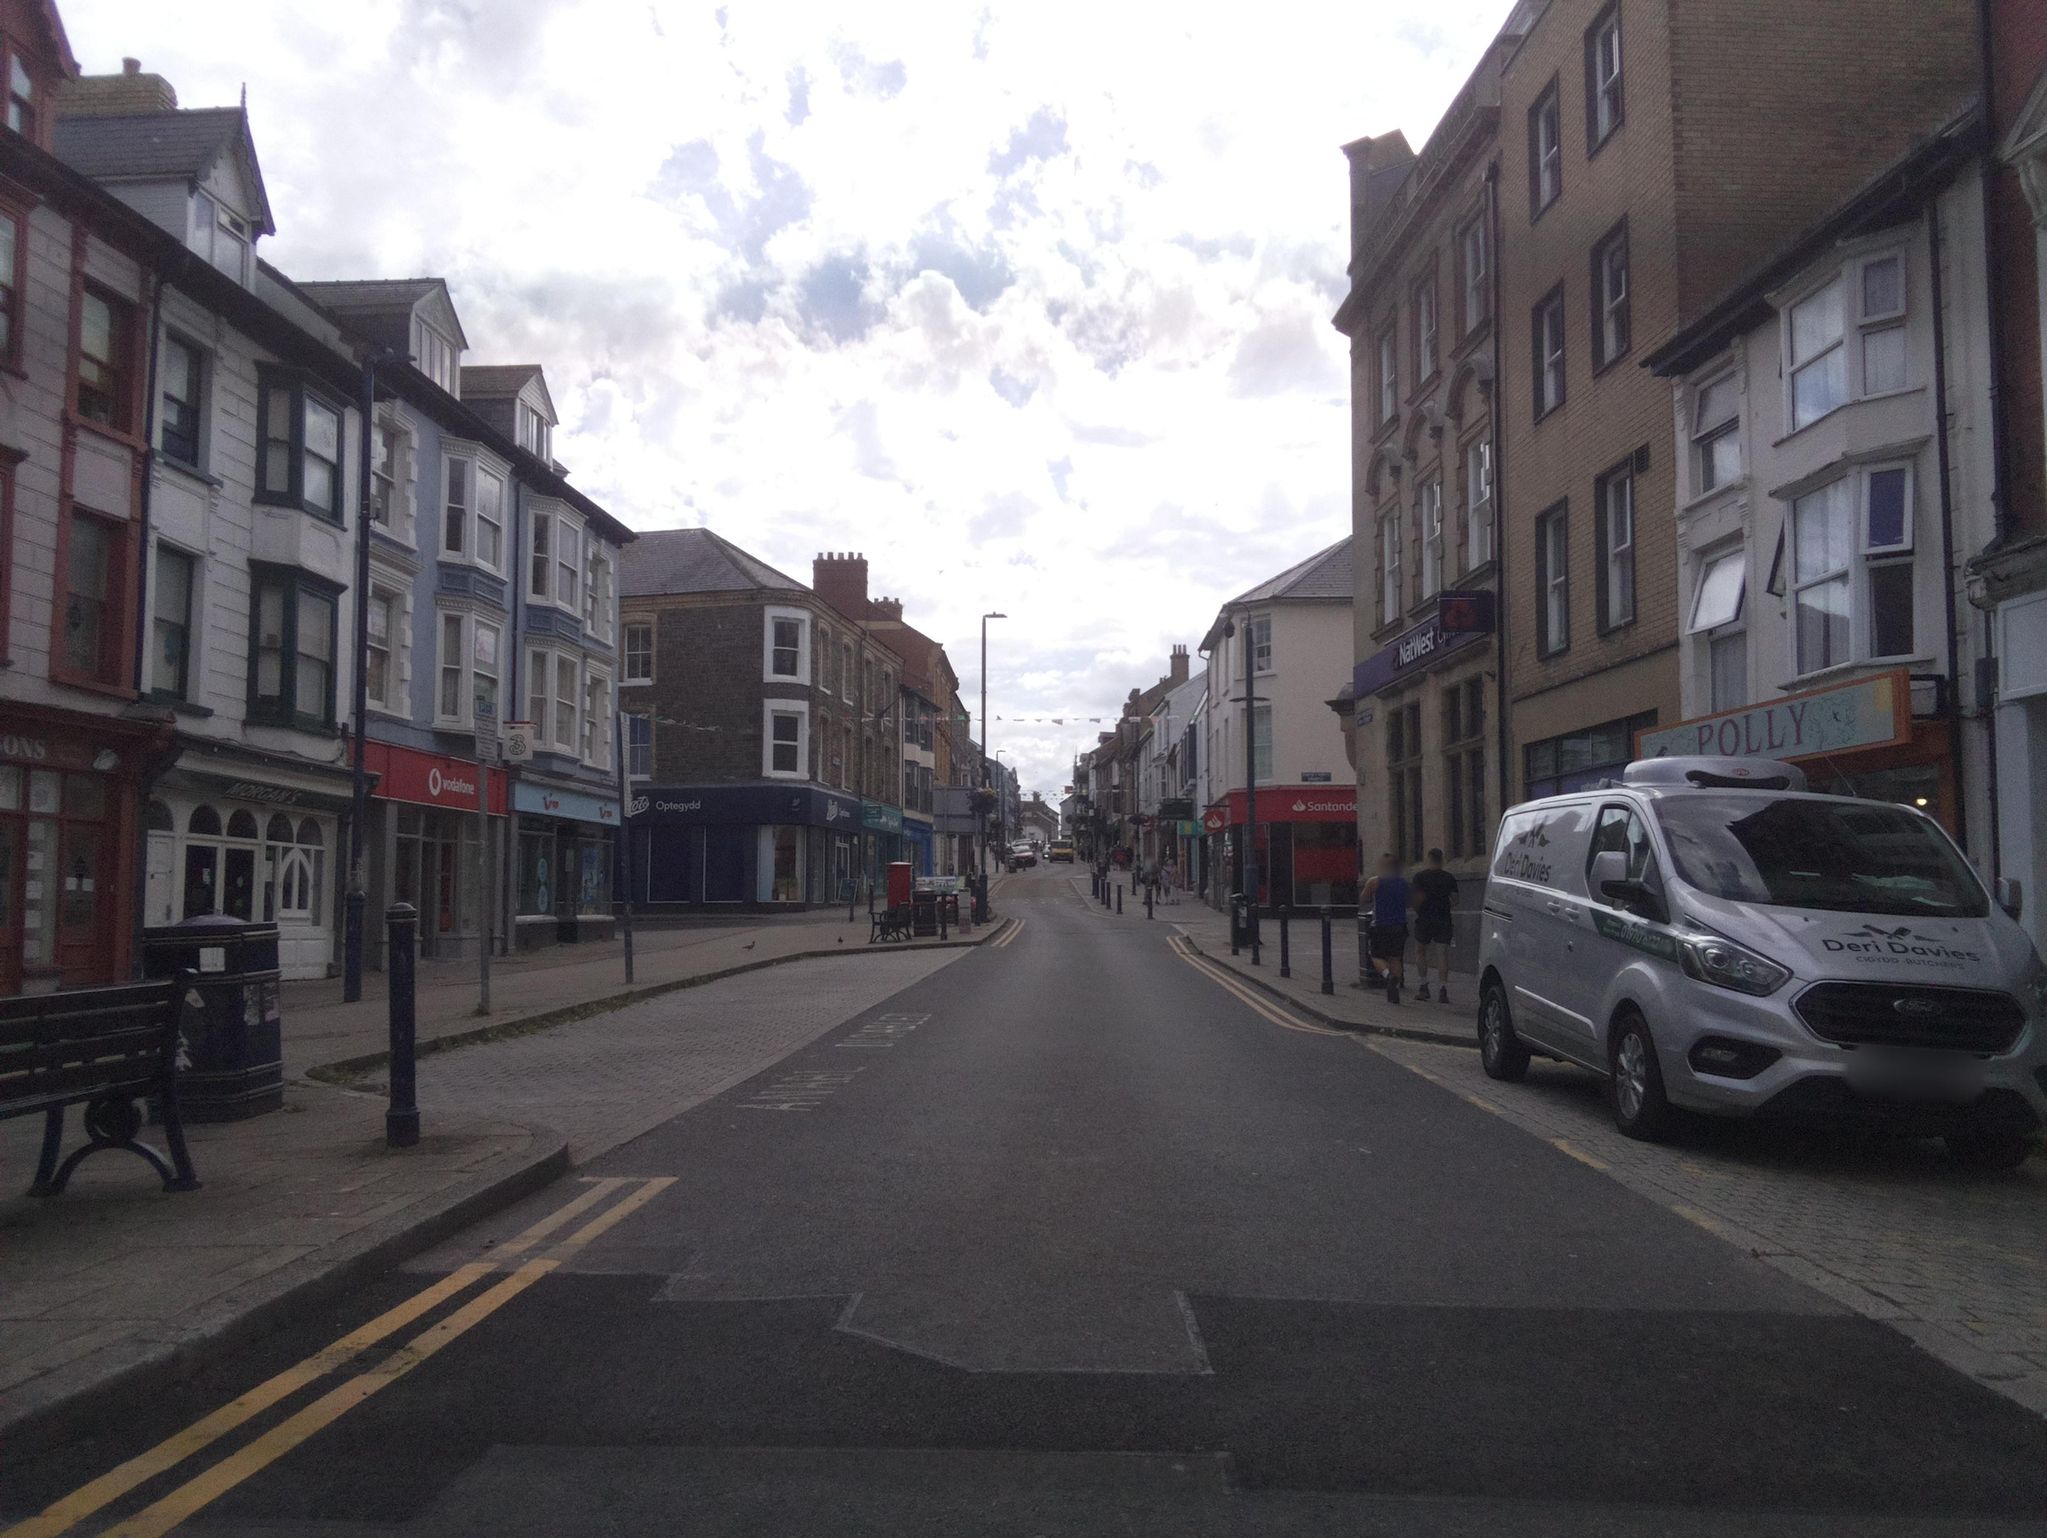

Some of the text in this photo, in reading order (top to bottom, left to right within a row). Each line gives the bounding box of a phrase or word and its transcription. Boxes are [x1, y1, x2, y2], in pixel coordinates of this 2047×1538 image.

[1398, 626, 1435, 667] NatWest
[1696, 701, 1809, 756] POLLY
[442, 777, 475, 796] vodafone
[655, 800, 702, 813] Optegydd
[1307, 801, 1358, 812] Santande
[1520, 854, 1552, 882] Davies
[1822, 938, 1981, 962] Deri Davies
